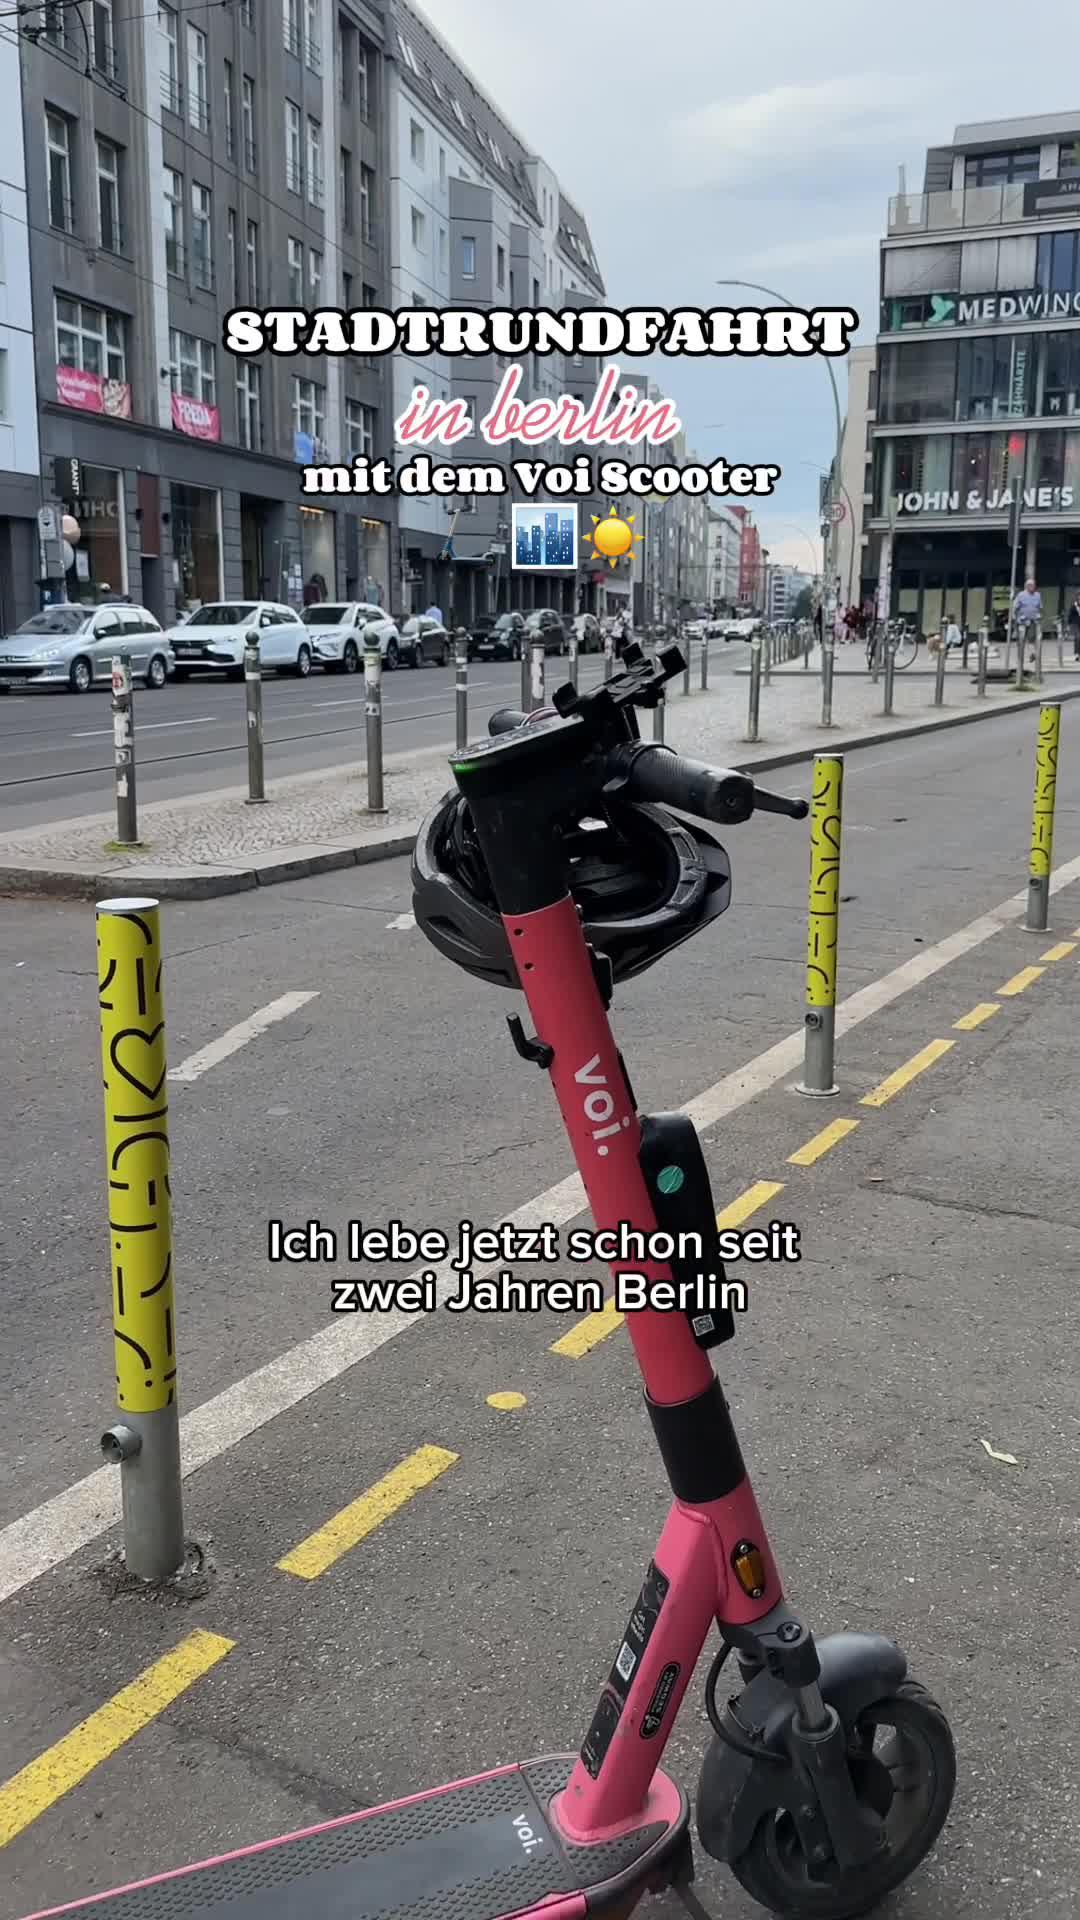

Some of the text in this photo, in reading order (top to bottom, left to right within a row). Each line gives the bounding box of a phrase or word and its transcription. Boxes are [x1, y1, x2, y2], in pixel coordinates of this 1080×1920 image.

[966, 490, 983, 510] &
[574, 1052, 631, 1157] voi.
[511, 1813, 544, 1854] voi.
